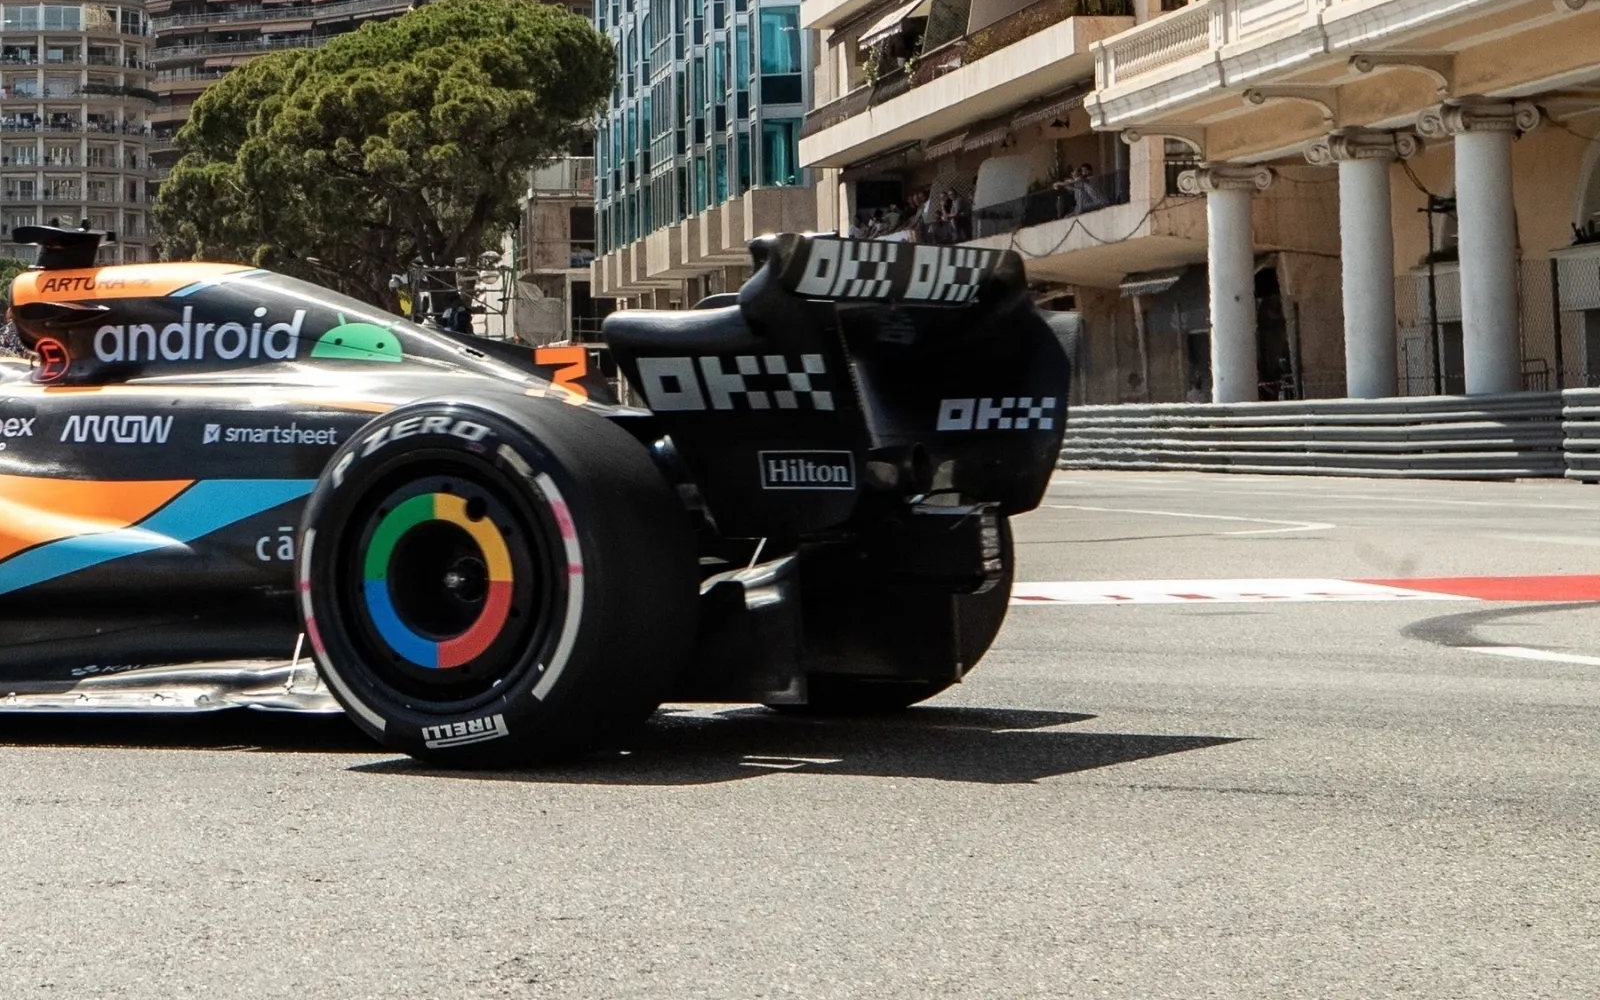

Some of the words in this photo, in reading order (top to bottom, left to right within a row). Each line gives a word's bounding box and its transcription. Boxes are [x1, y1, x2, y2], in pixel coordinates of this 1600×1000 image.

[41, 277, 125, 293] ARTURA
[796, 238, 896, 298] OKX
[904, 245, 988, 301] OKX
[94, 306, 305, 363] android
[636, 354, 834, 410] OKX
[60, 415, 173, 443] ARROW
[937, 397, 1056, 431] OKX
[225, 424, 337, 446] smartsheet
[361, 416, 492, 459] ZERO
[768, 458, 850, 484] Hilton
[421, 713, 509, 749] PIRELLI
